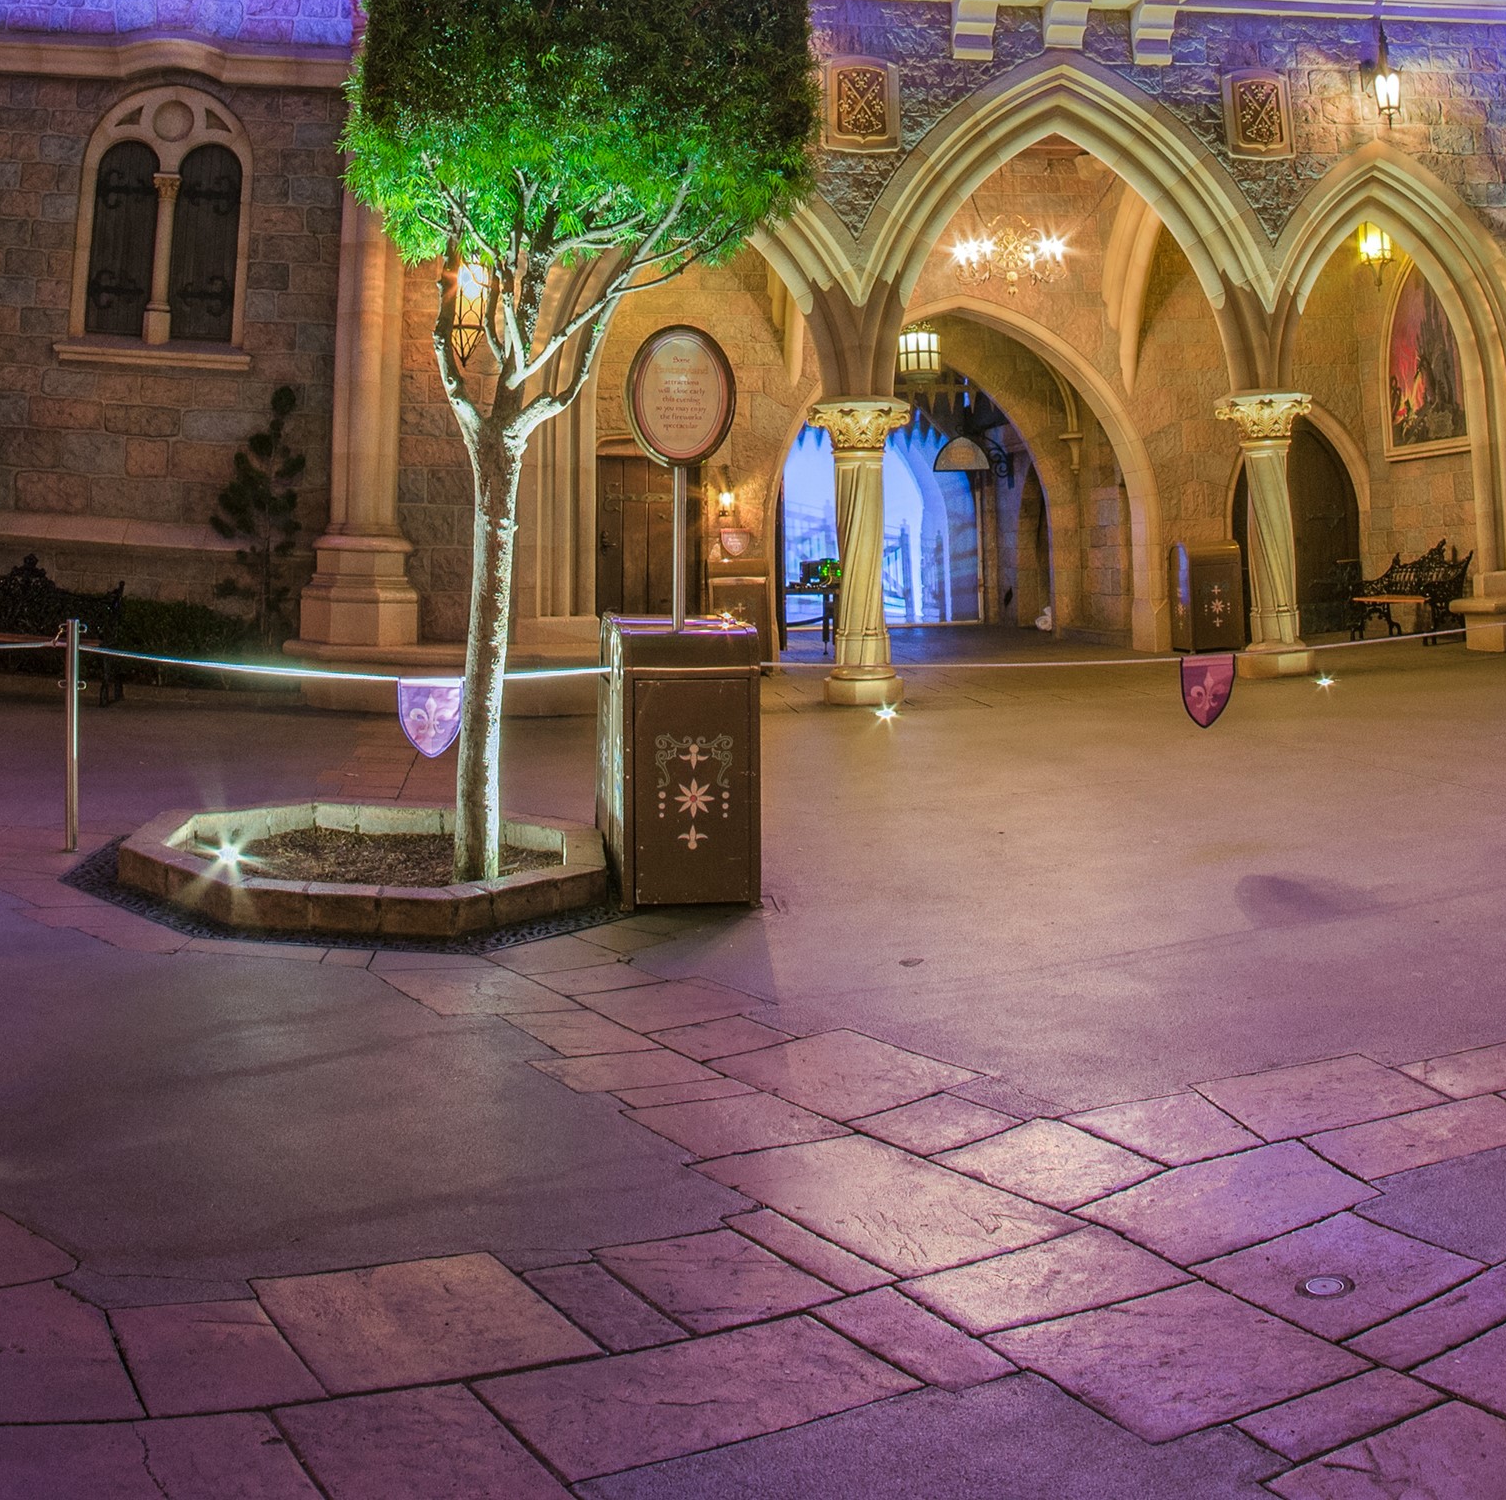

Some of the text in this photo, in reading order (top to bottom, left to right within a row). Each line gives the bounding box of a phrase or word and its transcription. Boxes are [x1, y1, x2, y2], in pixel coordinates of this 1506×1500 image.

[689, 388, 706, 396] early
[662, 395, 675, 403] this
[663, 405, 675, 413] you
[662, 422, 699, 431] spectacular
